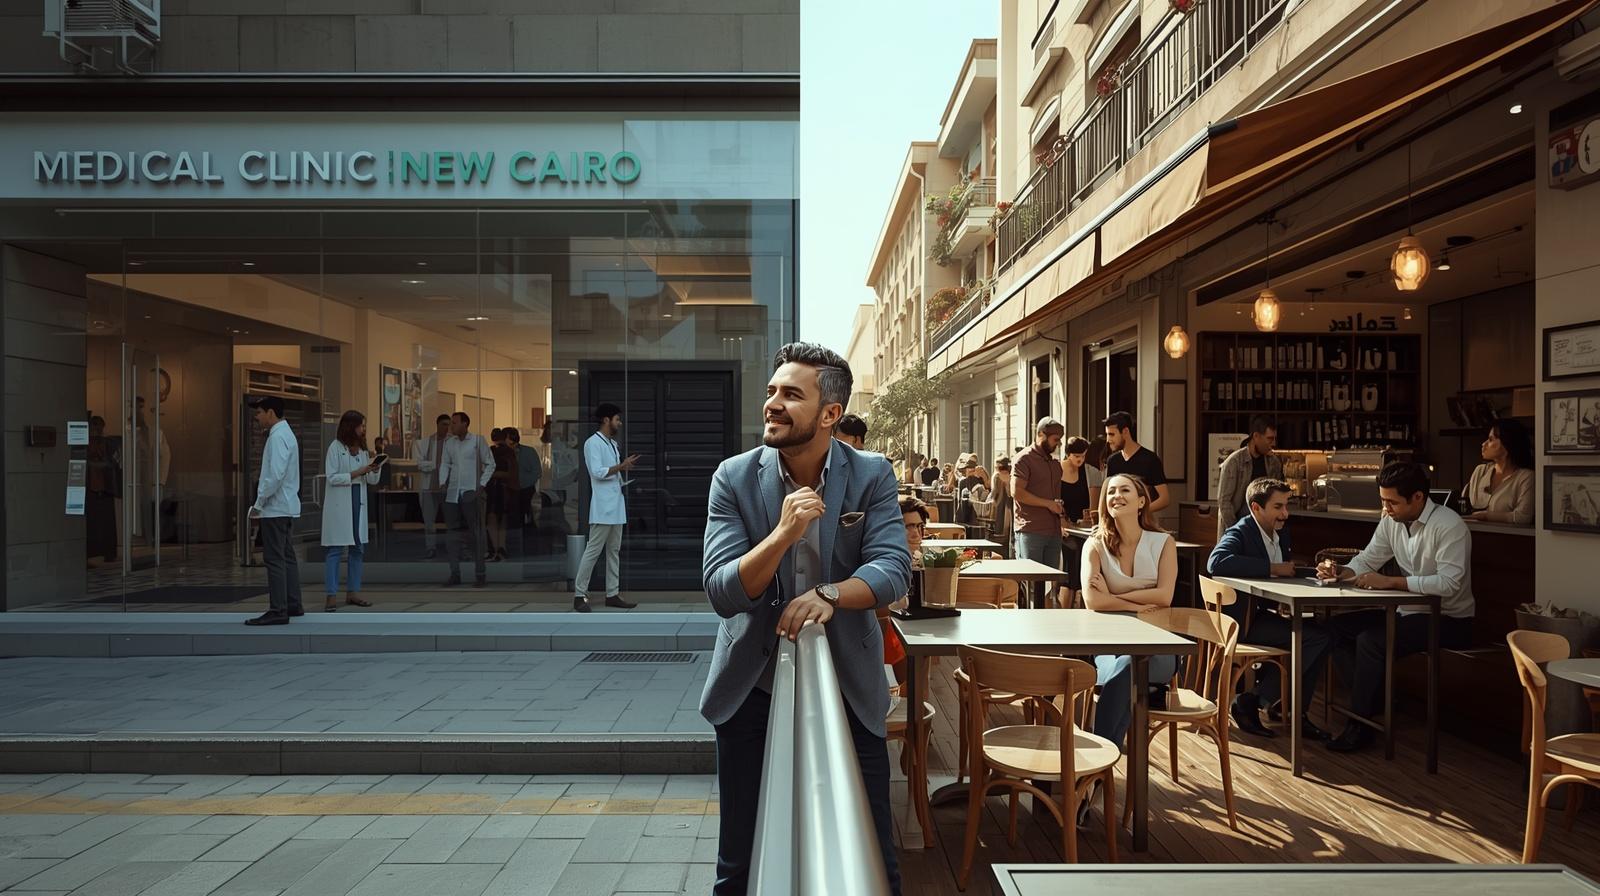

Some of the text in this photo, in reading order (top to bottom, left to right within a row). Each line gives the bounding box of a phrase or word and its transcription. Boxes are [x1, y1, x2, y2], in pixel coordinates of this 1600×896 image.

[33, 150, 642, 184] MEDICAL CLINIC NEW CAIRO
